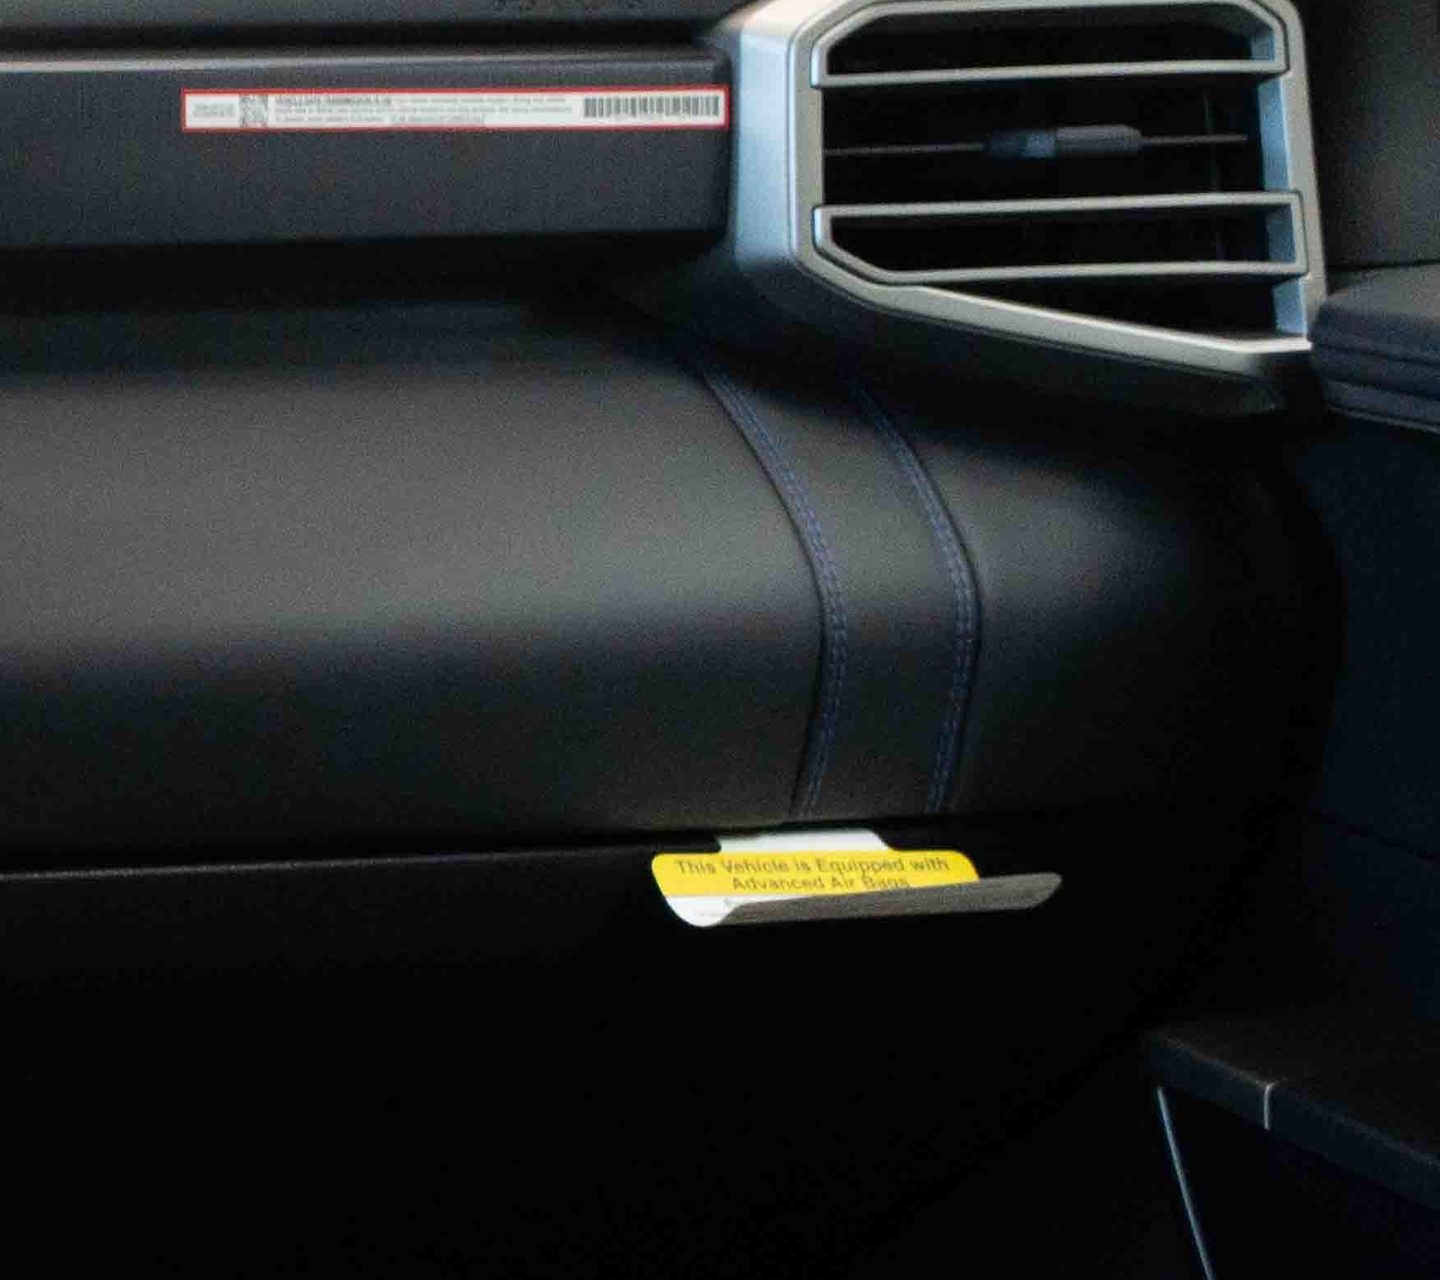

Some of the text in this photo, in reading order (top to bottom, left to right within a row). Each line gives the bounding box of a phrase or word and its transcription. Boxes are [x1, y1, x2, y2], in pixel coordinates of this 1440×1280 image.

[674, 856, 950, 877] This Vehicle is Equipped with
[731, 876, 826, 891] Advanced
[834, 876, 856, 890] Air
